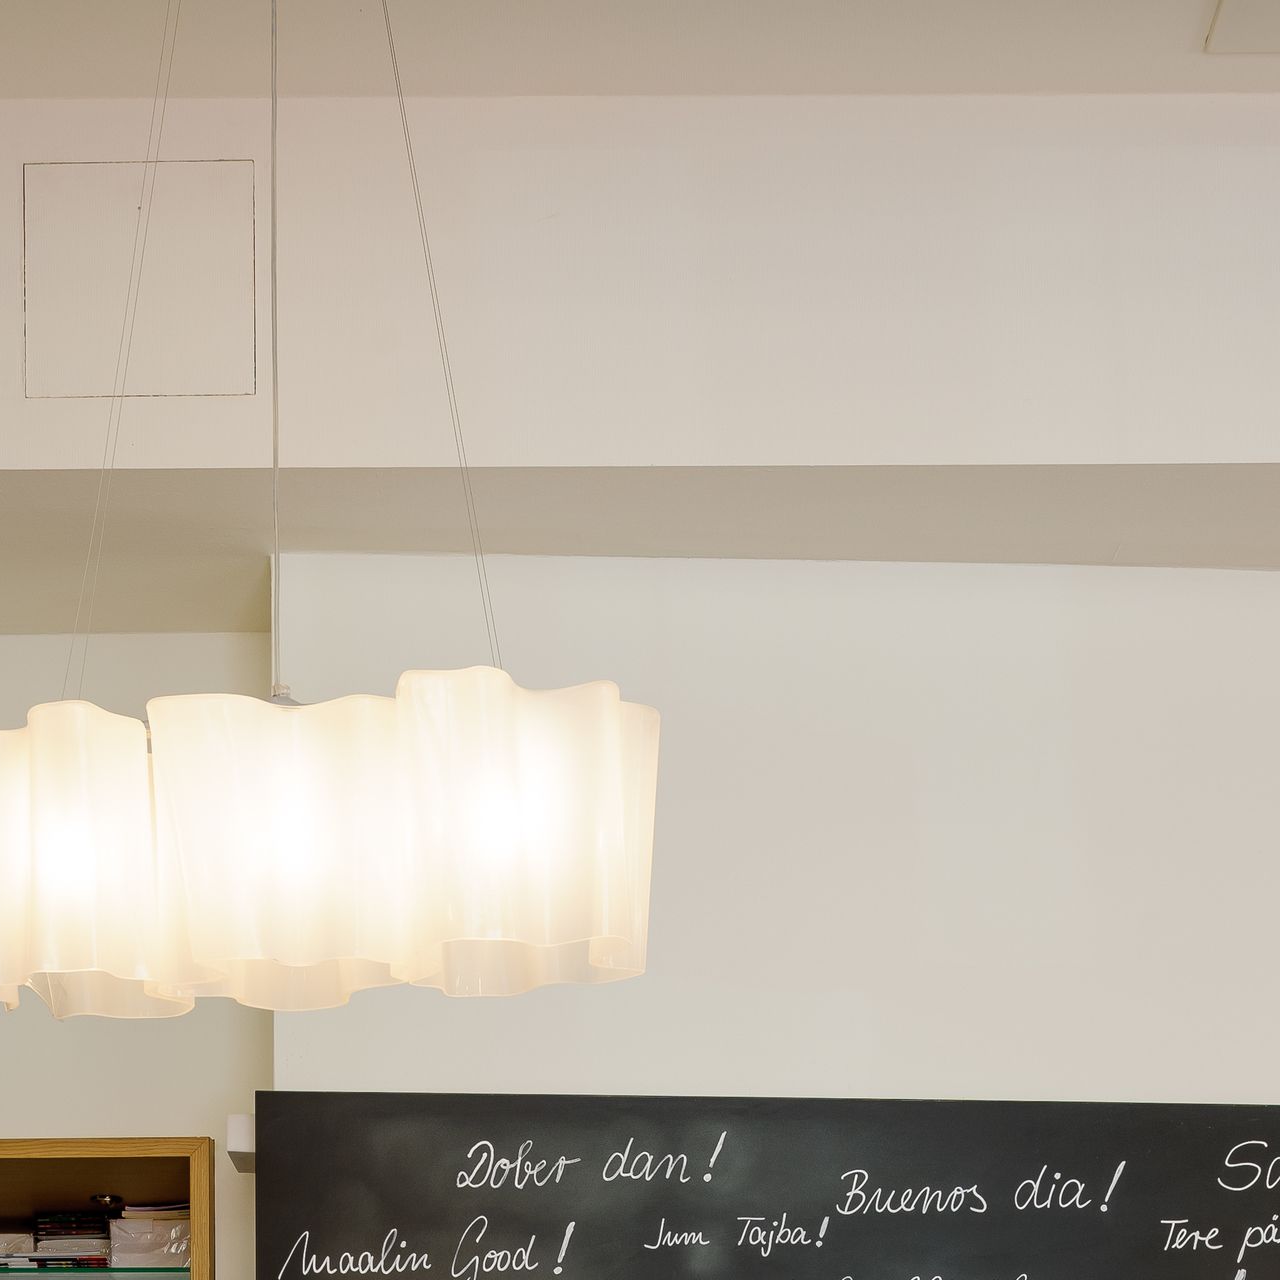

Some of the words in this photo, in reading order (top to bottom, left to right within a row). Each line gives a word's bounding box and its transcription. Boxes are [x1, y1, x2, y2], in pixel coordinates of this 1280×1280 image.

[457, 1140, 581, 1189] Dober
[603, 1131, 727, 1183] dan!
[836, 1170, 987, 1214] Buenos
[1015, 1161, 1126, 1212] dia!
[278, 1229, 431, 1280] Maalin
[644, 1218, 710, 1249] Jum
[737, 1213, 829, 1257] Tajba!
[1161, 1219, 1223, 1250] Tere
